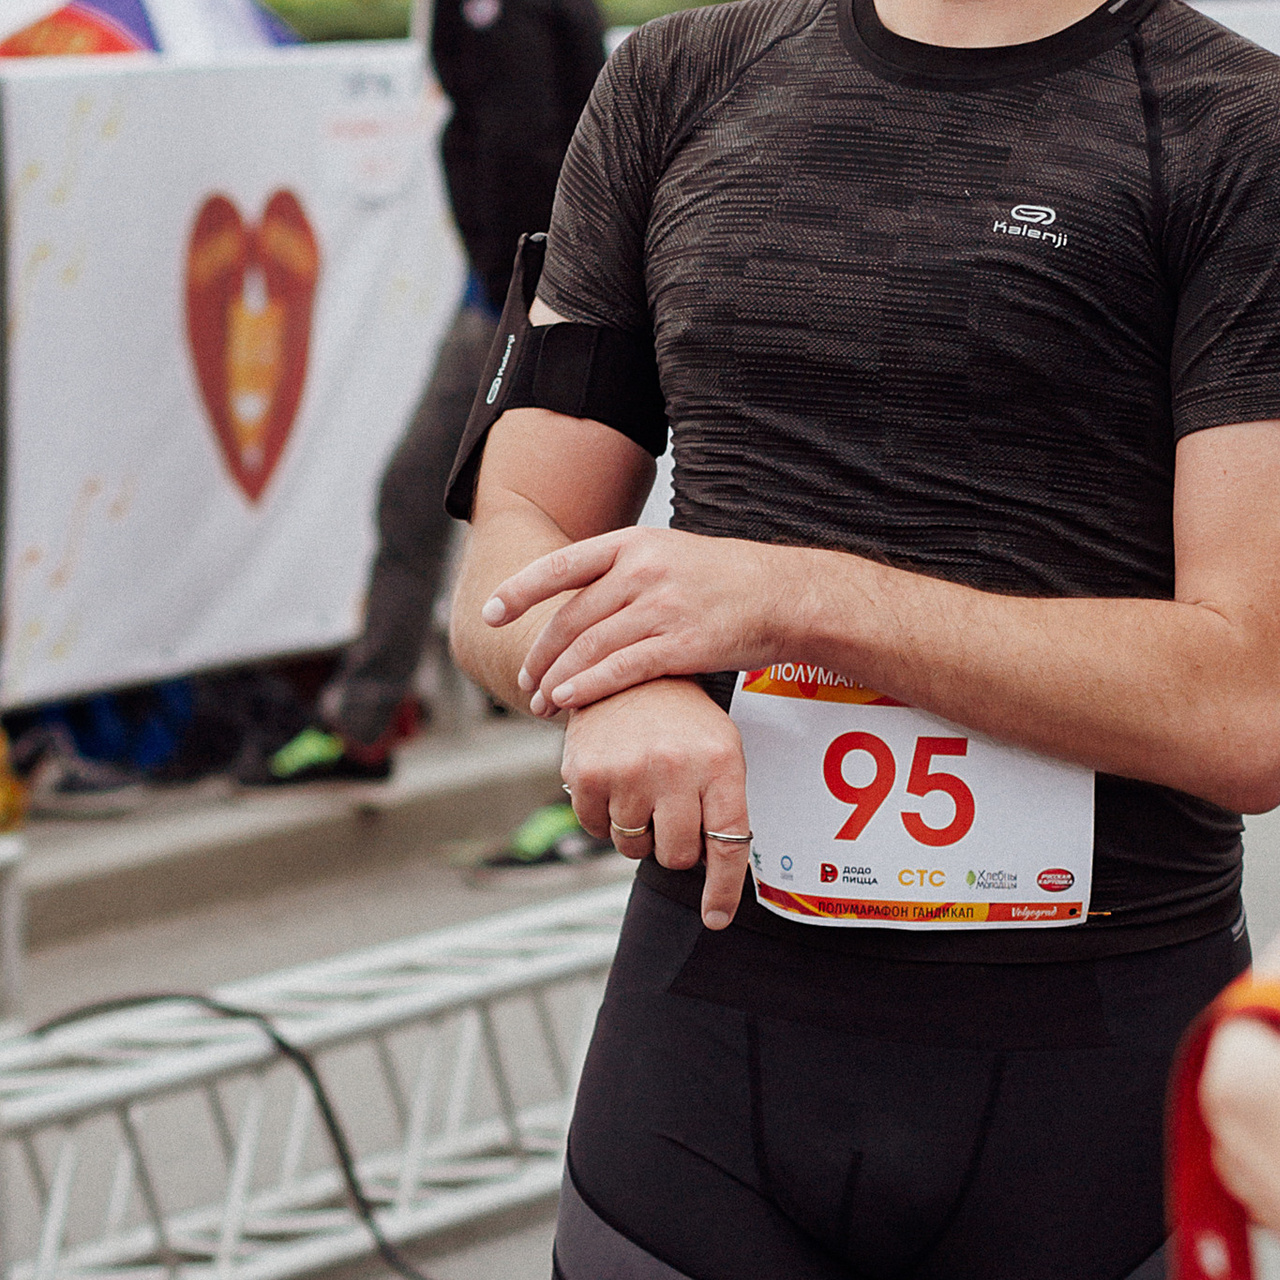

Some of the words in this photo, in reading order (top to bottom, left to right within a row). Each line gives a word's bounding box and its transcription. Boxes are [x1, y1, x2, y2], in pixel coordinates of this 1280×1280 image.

[993, 220, 1068, 249] Kalenji
[770, 662, 864, 688] ПОЛУМА
[823, 730, 976, 848] 95
[842, 866, 872, 875] ДОДО
[898, 869, 946, 888] СТС
[842, 875, 879, 886] ПИЦЦА
[818, 901, 909, 919] ПОЛУМАРАФОН
[913, 906, 974, 920] ГАНДИКАП
